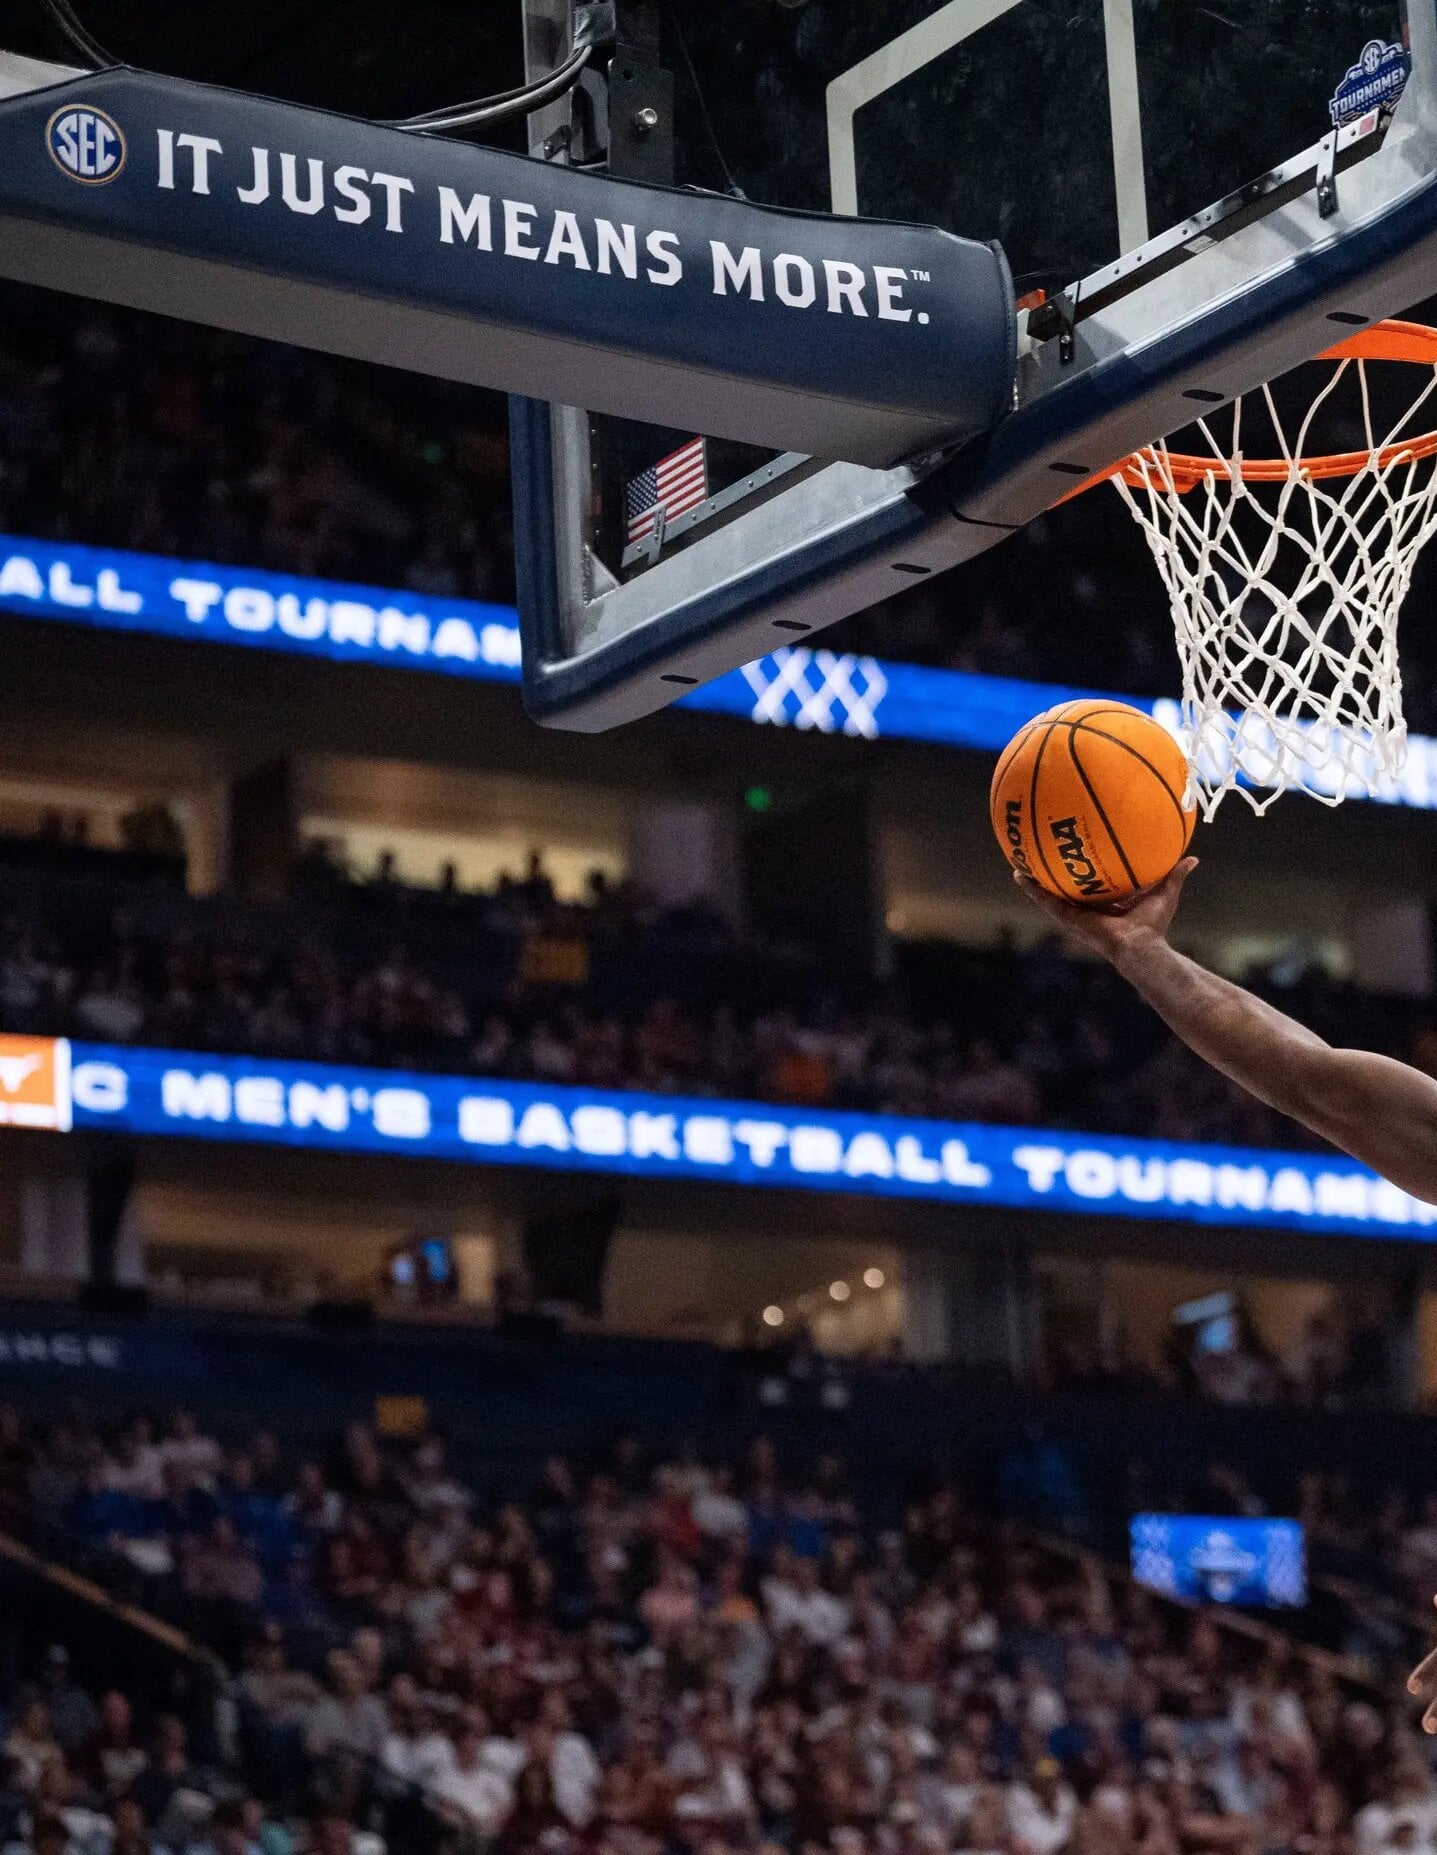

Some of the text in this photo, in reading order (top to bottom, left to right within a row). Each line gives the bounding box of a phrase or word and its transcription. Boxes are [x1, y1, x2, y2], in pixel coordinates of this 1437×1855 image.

[1332, 67, 1406, 120] TOURNAMEN
[56, 112, 118, 175] SEC
[157, 128, 223, 194] IT
[237, 147, 414, 233] JUST
[437, 186, 682, 287] MEANS
[170, 577, 523, 668] TOURNAM
[1049, 815, 1113, 896] NCAA
[161, 1068, 431, 1140] MEN'S
[458, 1096, 991, 1188] BASKETBALL
